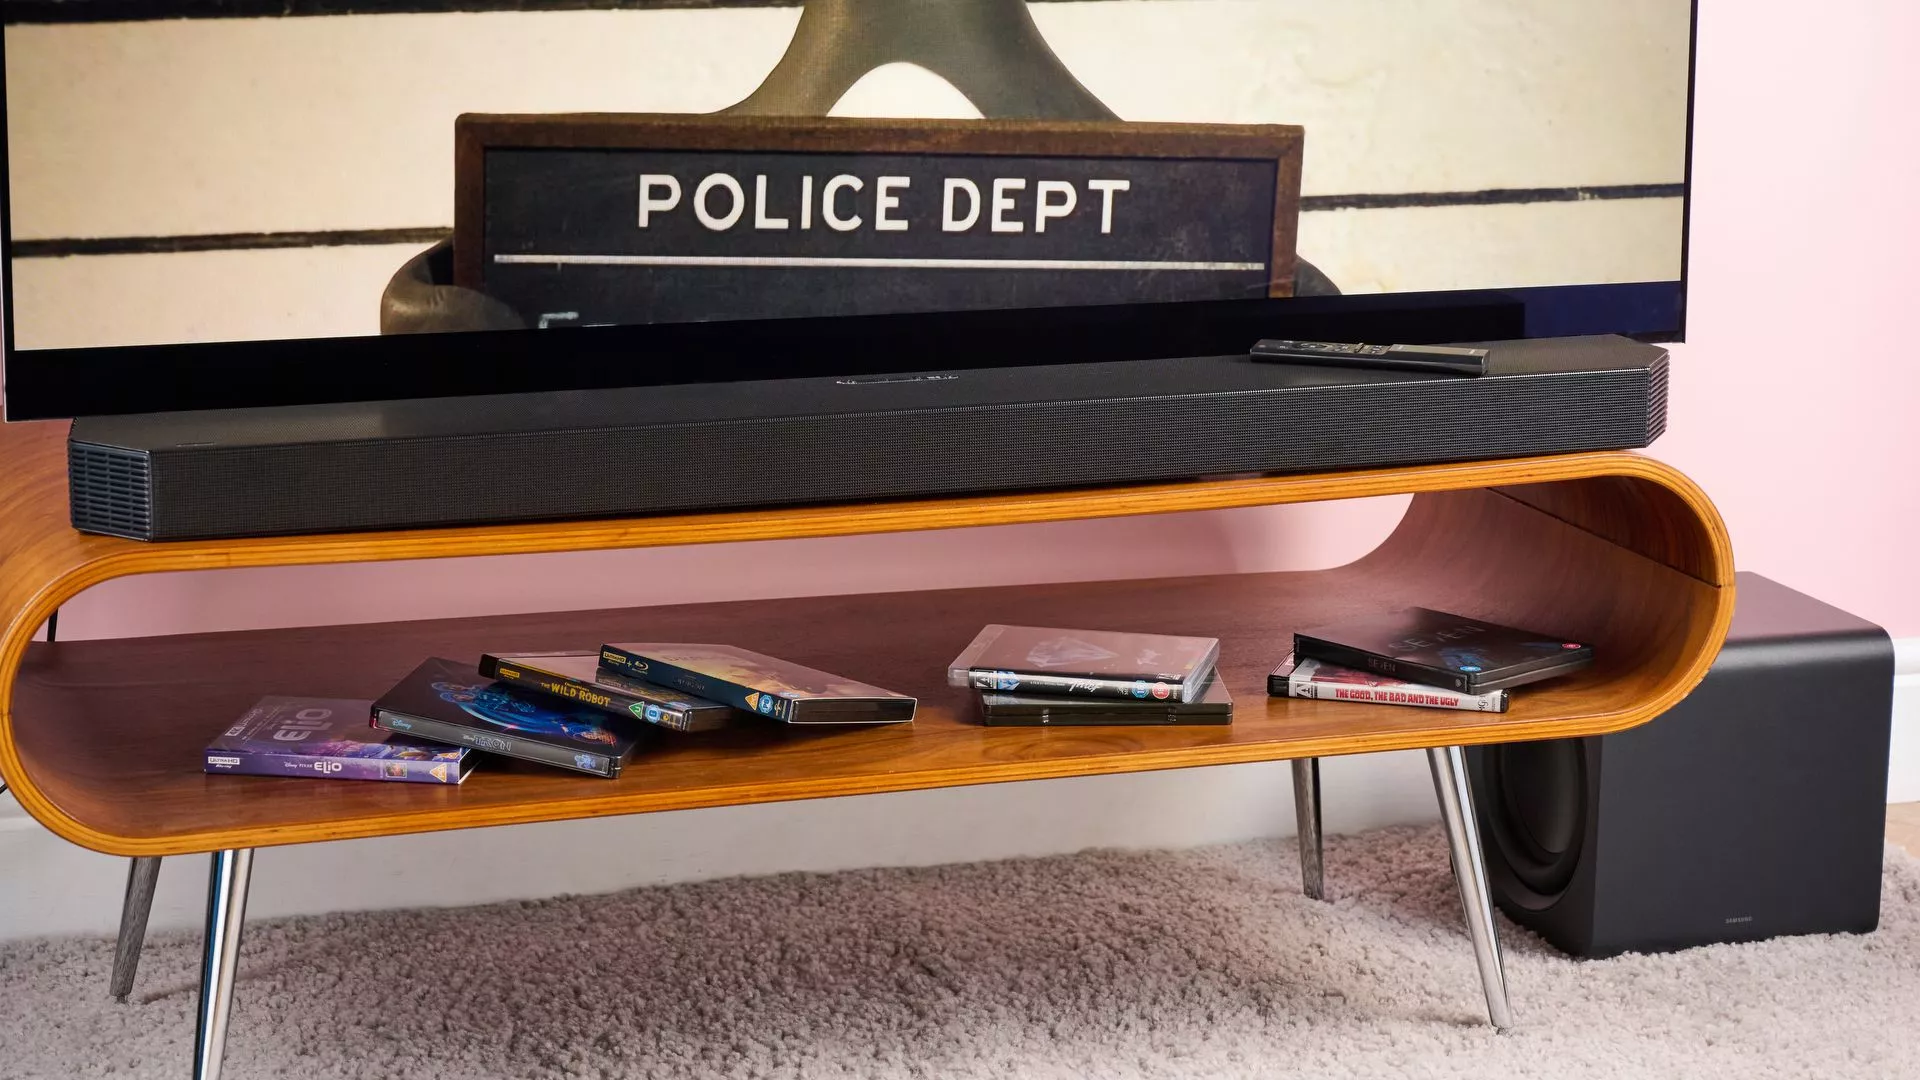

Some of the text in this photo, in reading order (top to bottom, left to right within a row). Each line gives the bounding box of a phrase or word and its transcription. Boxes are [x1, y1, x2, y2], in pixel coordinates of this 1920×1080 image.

[638, 172, 1130, 234] POLICE DEPT
[551, 682, 577, 697] WILD
[579, 691, 611, 707] ROBOT
[1335, 688, 1349, 698] THE
[1374, 691, 1387, 701] THE
[1389, 692, 1406, 702] BAD
[1407, 694, 1426, 704] AND
[1426, 694, 1439, 704] THE
[1440, 696, 1459, 707] UGLY
[475, 736, 512, 752] TRON
